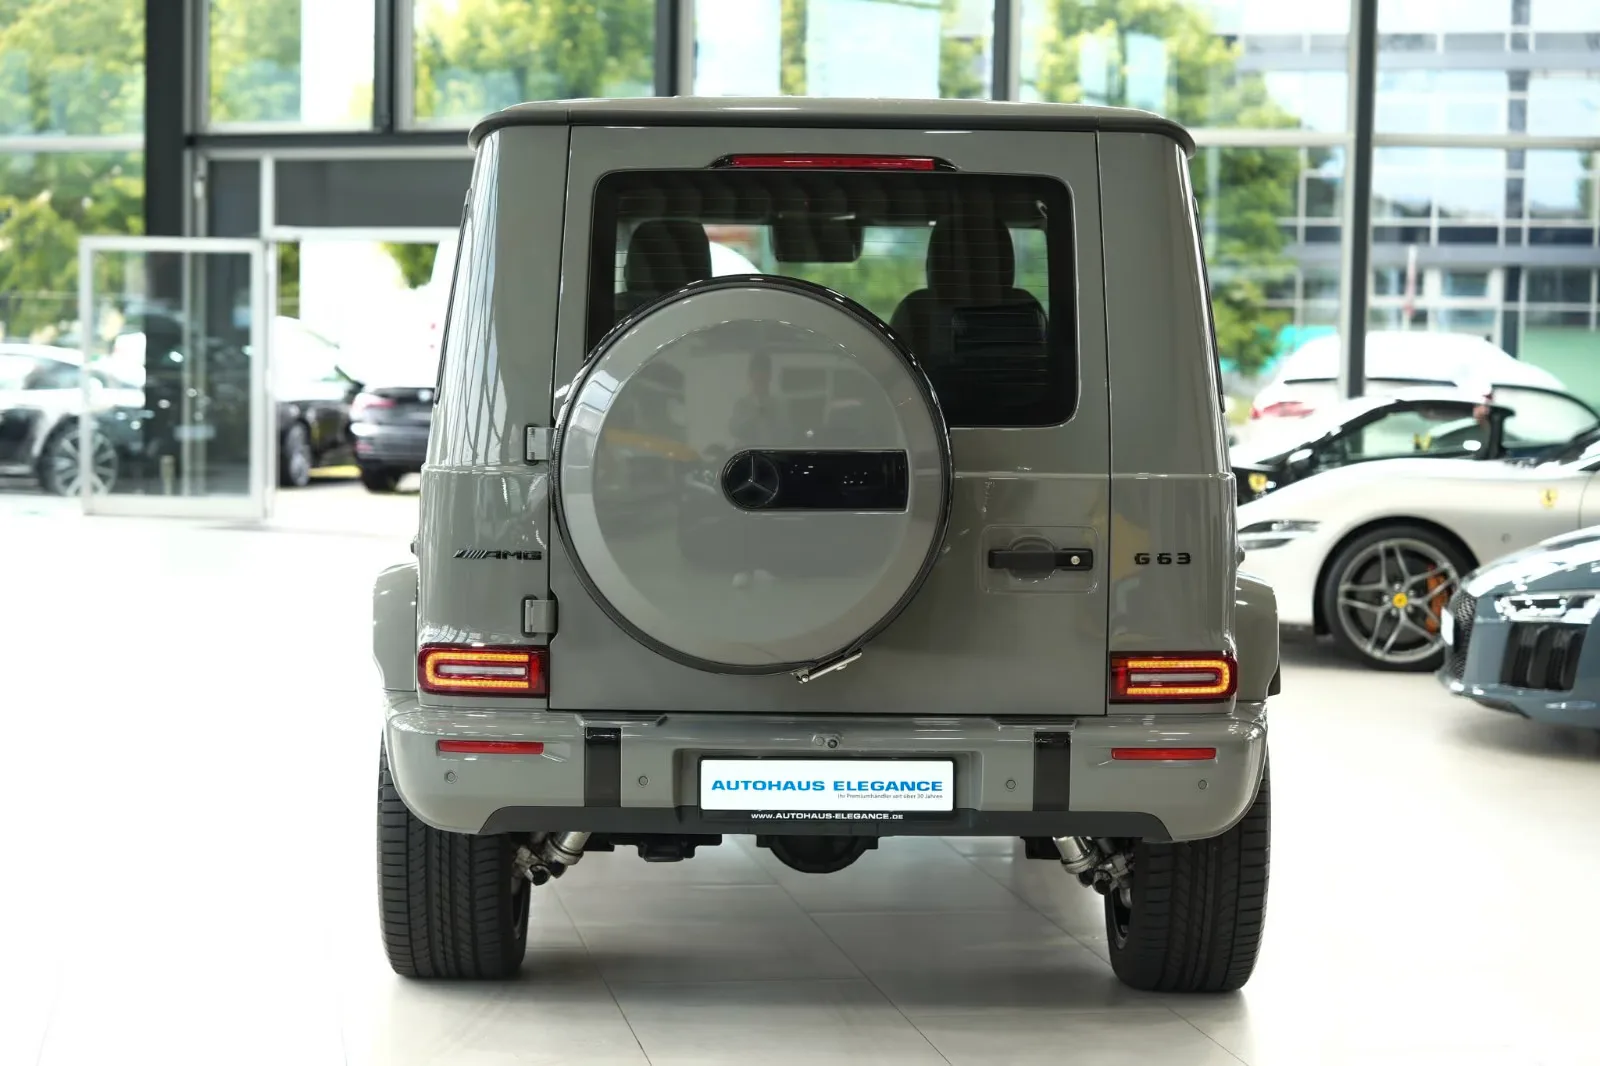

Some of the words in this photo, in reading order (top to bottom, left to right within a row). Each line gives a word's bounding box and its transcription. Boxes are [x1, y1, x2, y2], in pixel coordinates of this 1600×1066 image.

[485, 550, 542, 560] AMG
[1134, 552, 1150, 565] G
[1156, 552, 1191, 565] 63
[711, 780, 826, 791] AUTOHAUS
[833, 780, 943, 791] ELEGANCE
